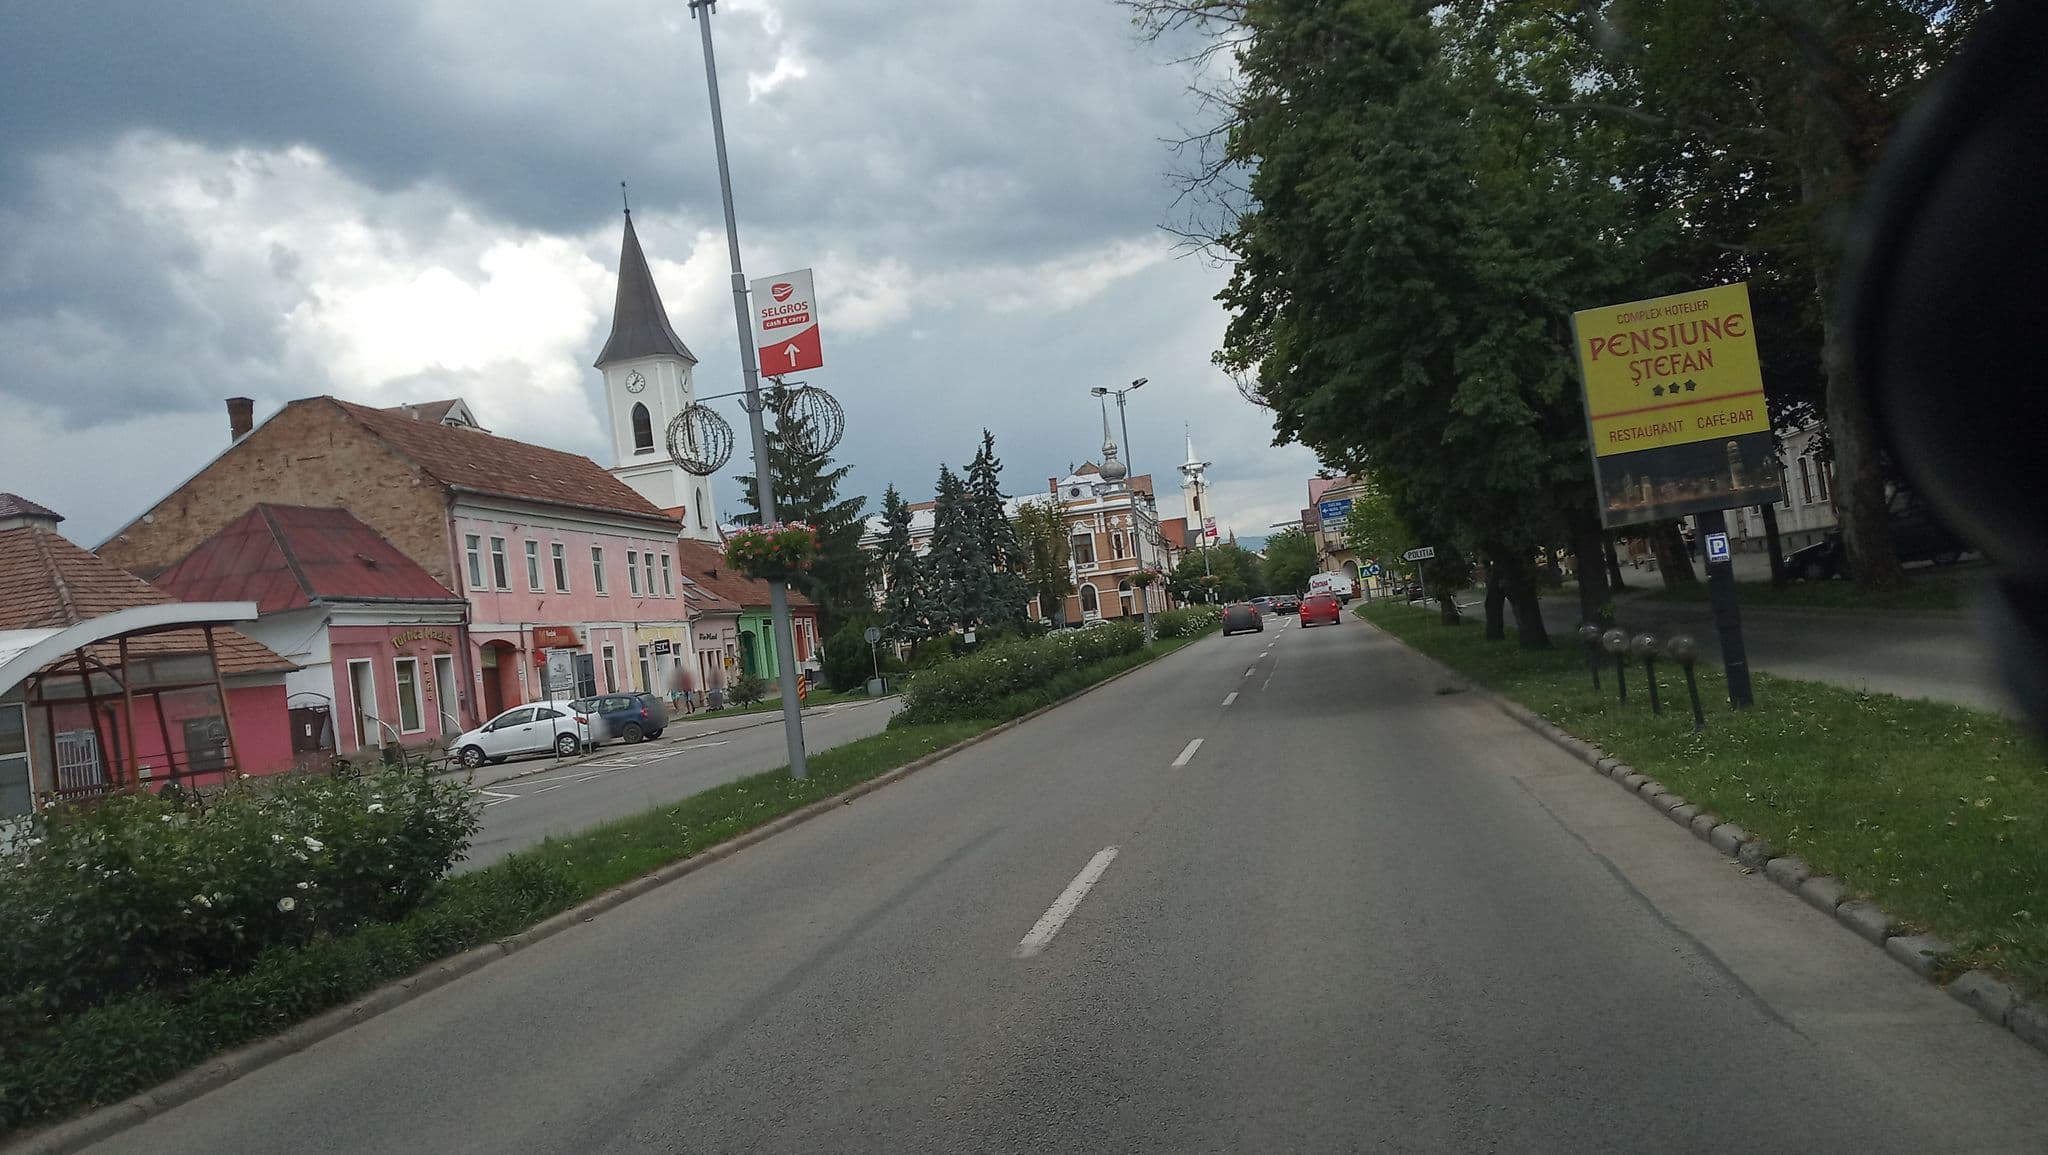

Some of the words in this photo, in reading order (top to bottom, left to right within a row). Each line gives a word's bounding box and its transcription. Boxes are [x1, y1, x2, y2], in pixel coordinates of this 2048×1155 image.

[761, 301, 808, 318] SELGROS
[1617, 307, 1663, 324] COMPLEX
[1664, 300, 1710, 316] HOTELIER
[766, 320, 782, 329] cash
[788, 315, 807, 324] carry
[1588, 313, 1748, 361] PENSIUNE
[1609, 419, 1684, 443] RESTAURANT
